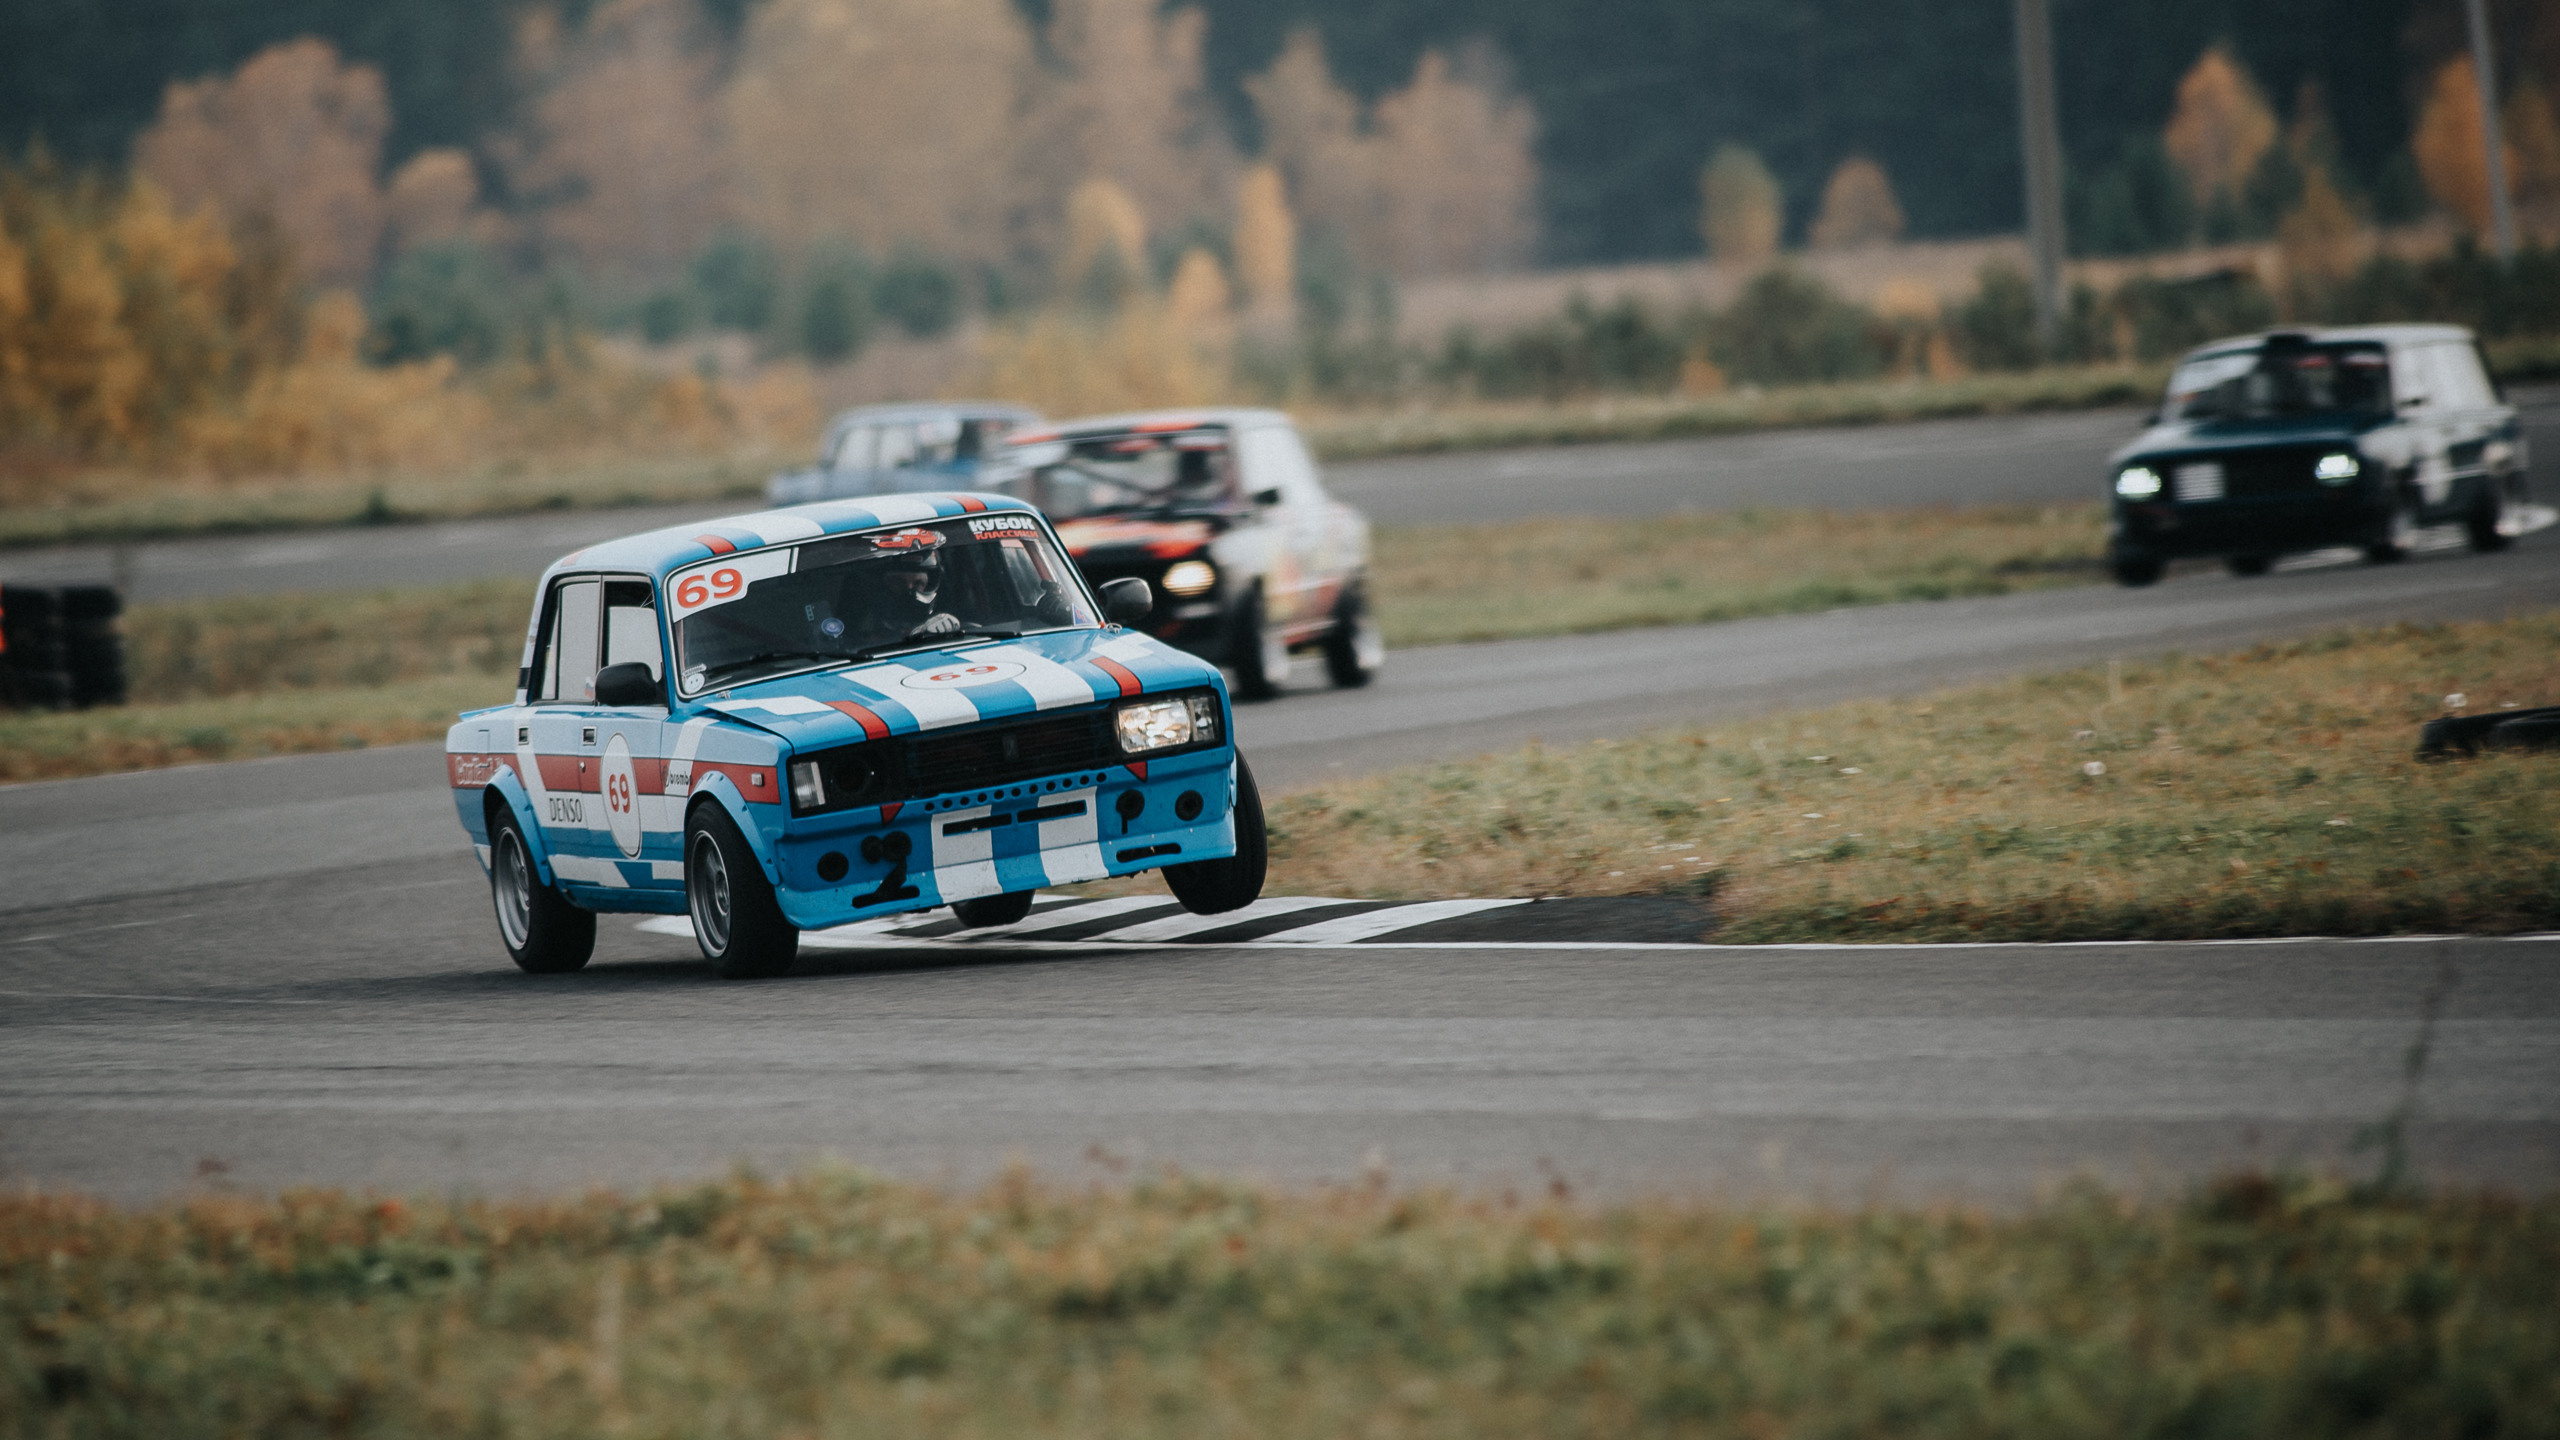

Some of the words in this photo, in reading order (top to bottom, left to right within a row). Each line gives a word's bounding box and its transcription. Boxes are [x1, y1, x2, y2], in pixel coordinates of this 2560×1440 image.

[968, 516, 1036, 532] КУБОК
[974, 530, 1039, 540] КЛАССИКИ
[677, 568, 743, 609] 69
[930, 666, 998, 681] 69
[609, 773, 630, 814] 69
[549, 798, 583, 823] DENSO
